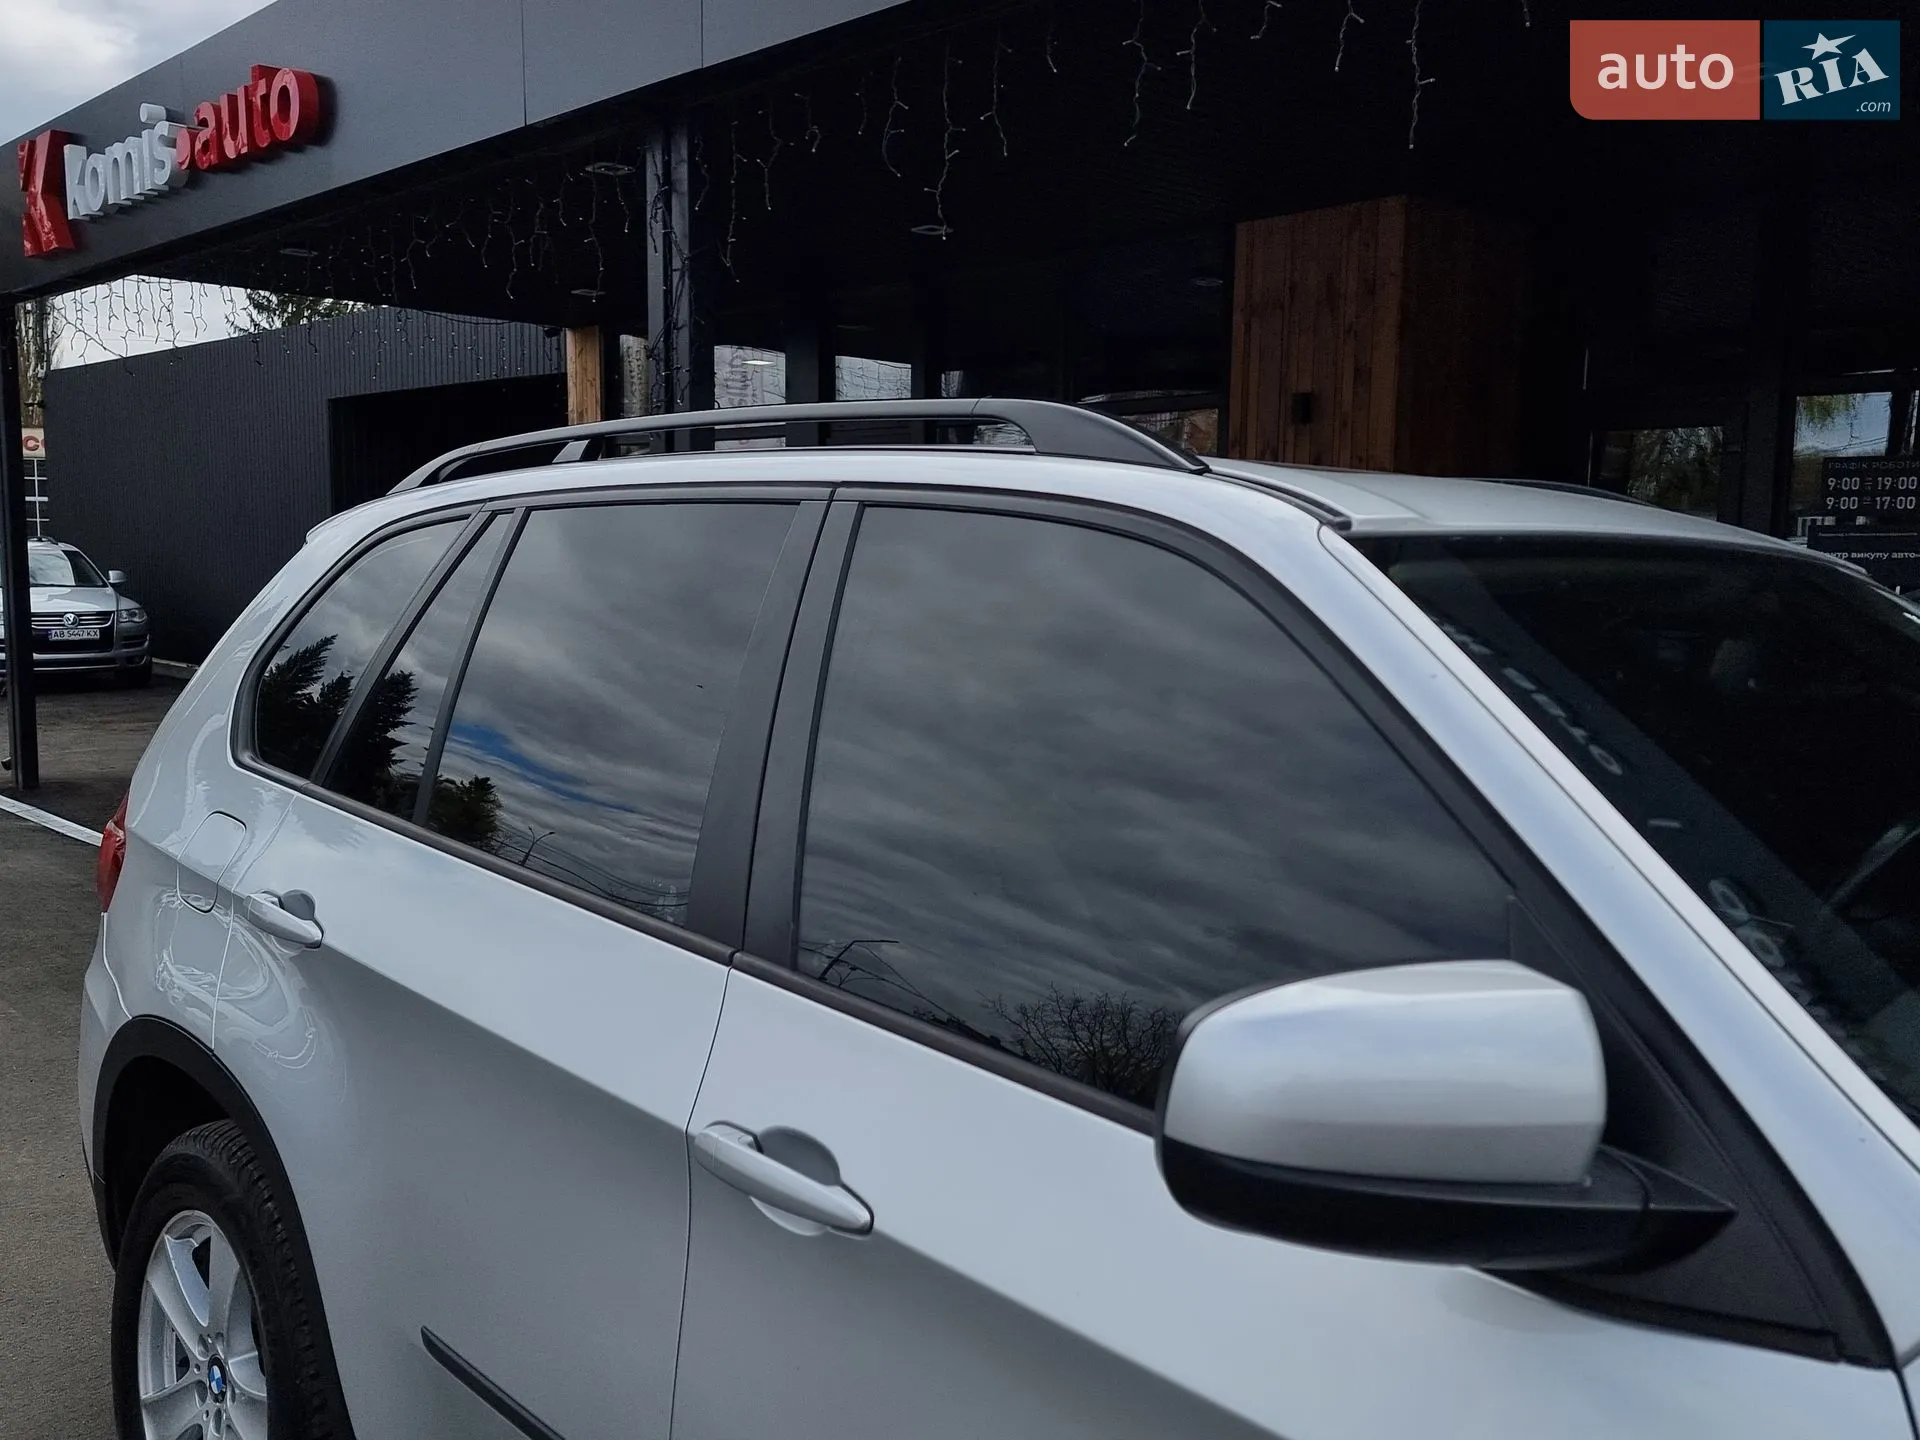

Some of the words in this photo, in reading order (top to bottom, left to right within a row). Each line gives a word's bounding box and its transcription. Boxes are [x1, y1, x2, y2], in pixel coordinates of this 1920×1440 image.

[1827, 477, 1860, 491] 9:00
[1876, 476, 1918, 490] 19:00
[1826, 496, 1858, 510] 9:00
[1875, 496, 1916, 510] 17:00
[1851, 552, 1889, 560] викупу
[53, 630, 65, 638] AB
[86, 629, 98, 637] KX
